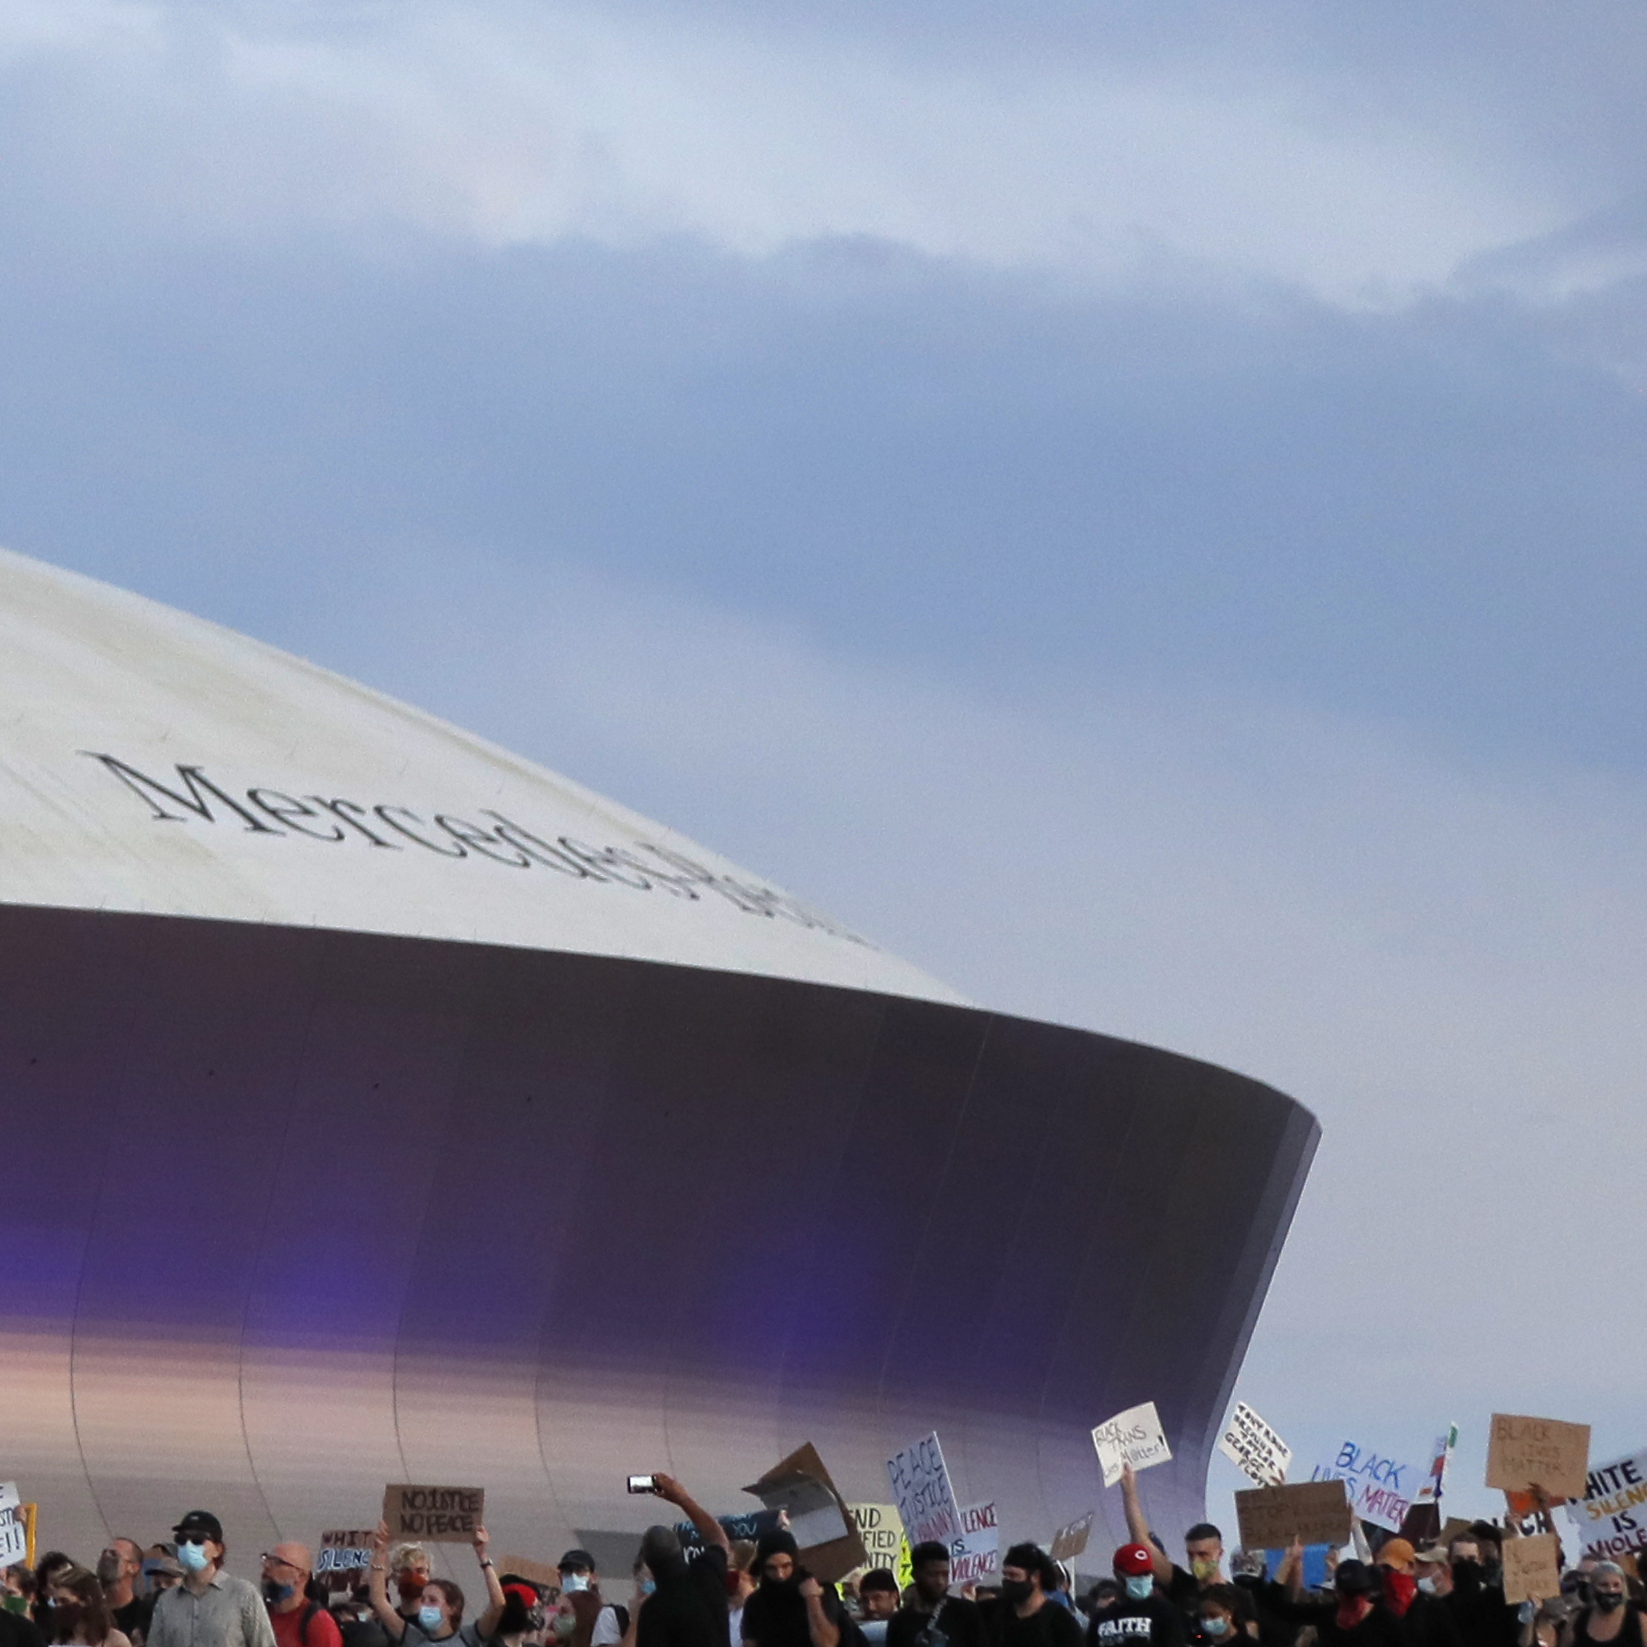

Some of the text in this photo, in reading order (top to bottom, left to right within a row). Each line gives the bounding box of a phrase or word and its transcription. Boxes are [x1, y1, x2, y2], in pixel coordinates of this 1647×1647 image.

[887, 1437, 943, 1497] PEACE
[1335, 1441, 1406, 1489] BLACK
[1569, 1459, 1643, 1506] HITE
[401, 1490, 427, 1510] NO
[1356, 1484, 1411, 1525] MATTER
[400, 1513, 475, 1535] NO PEACE
[1611, 1510, 1637, 1533] IS
[322, 1531, 374, 1545] WHIT
[317, 1548, 373, 1572] SILENC
